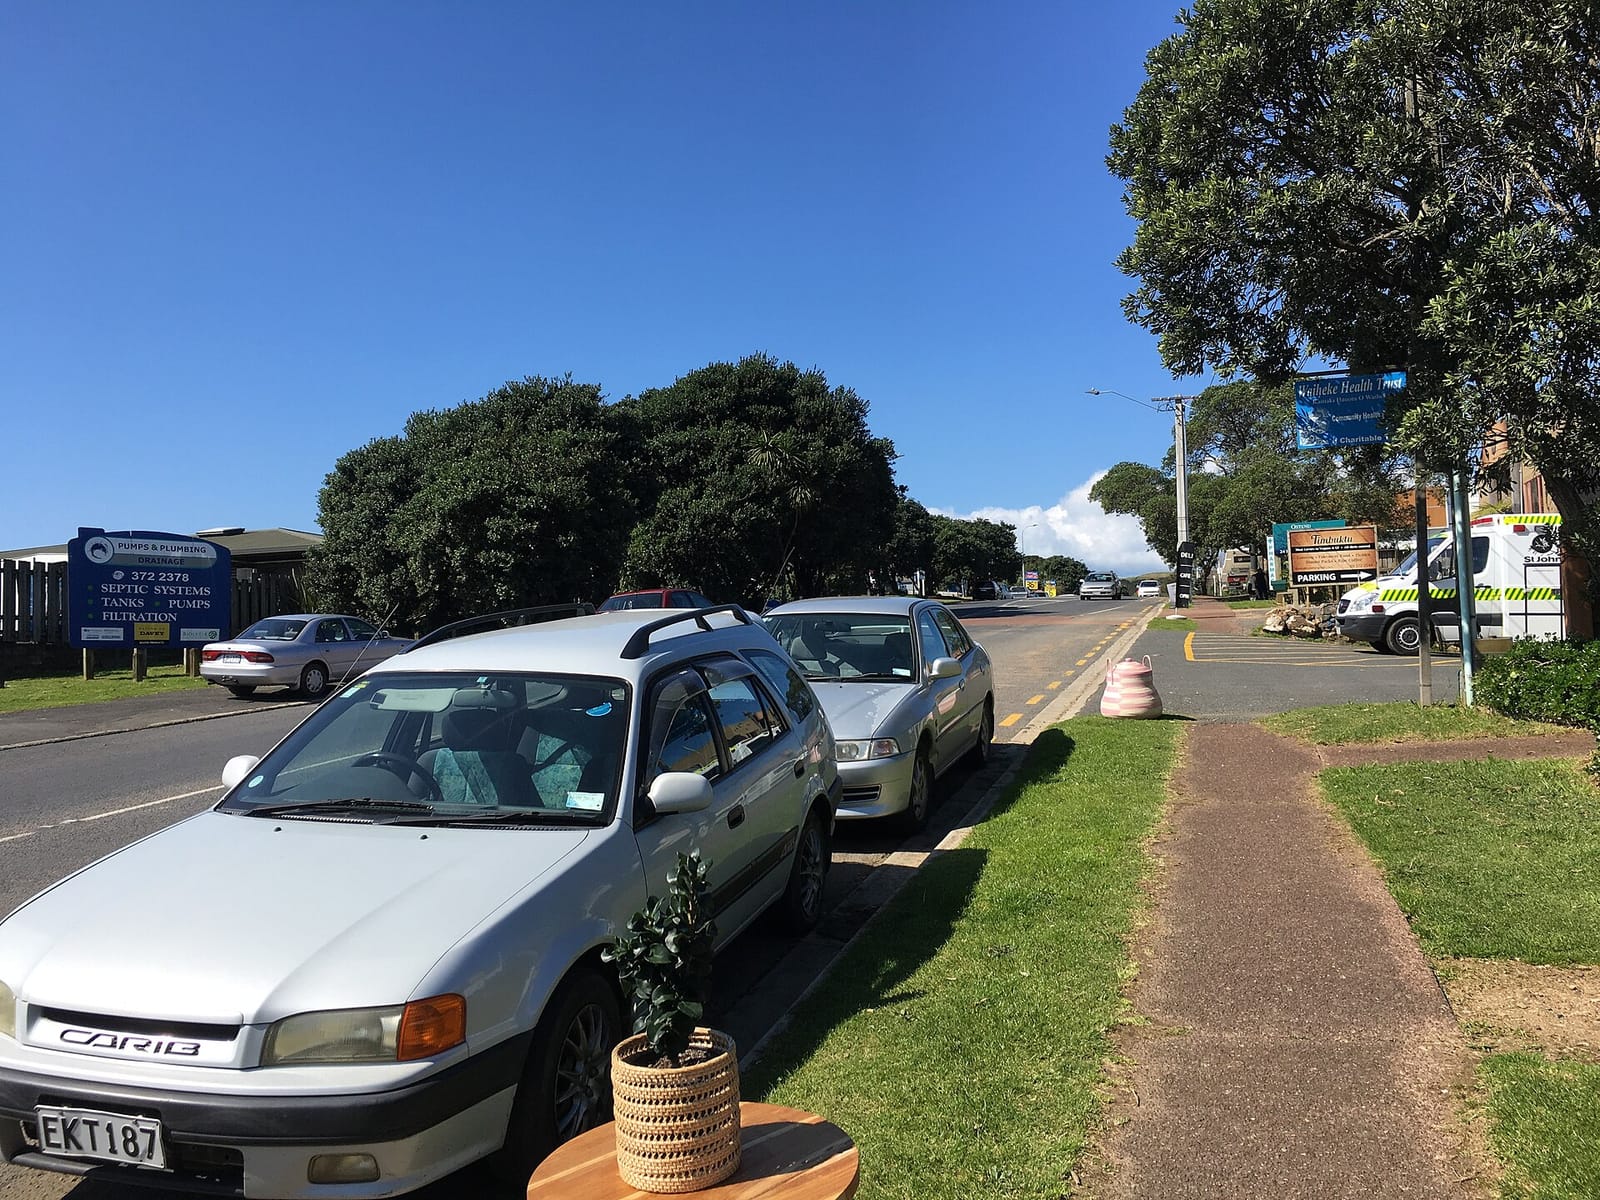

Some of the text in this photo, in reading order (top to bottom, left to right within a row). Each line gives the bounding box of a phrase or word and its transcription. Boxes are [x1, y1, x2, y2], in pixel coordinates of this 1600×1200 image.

[1299, 377, 1402, 398] Waiheke Health Trust
[1331, 413, 1362, 423] Community
[1339, 436, 1382, 444] Charitable
[1311, 534, 1353, 545] Timbuktu
[118, 542, 149, 551] PUMPS
[160, 544, 207, 554] PLUMBING
[138, 556, 185, 566] DRAINAGE
[1268, 544, 1276, 581] PHARMA
[131, 571, 190, 582] 372 2378
[1297, 573, 1337, 582] PARKING
[101, 584, 211, 596] SEPTIC SYSTEMS
[101, 597, 211, 609] TANKS PUMPS
[102, 612, 178, 622] FILTRATION
[60, 1028, 201, 1056] CARIB
[42, 1114, 157, 1161] EKT187
